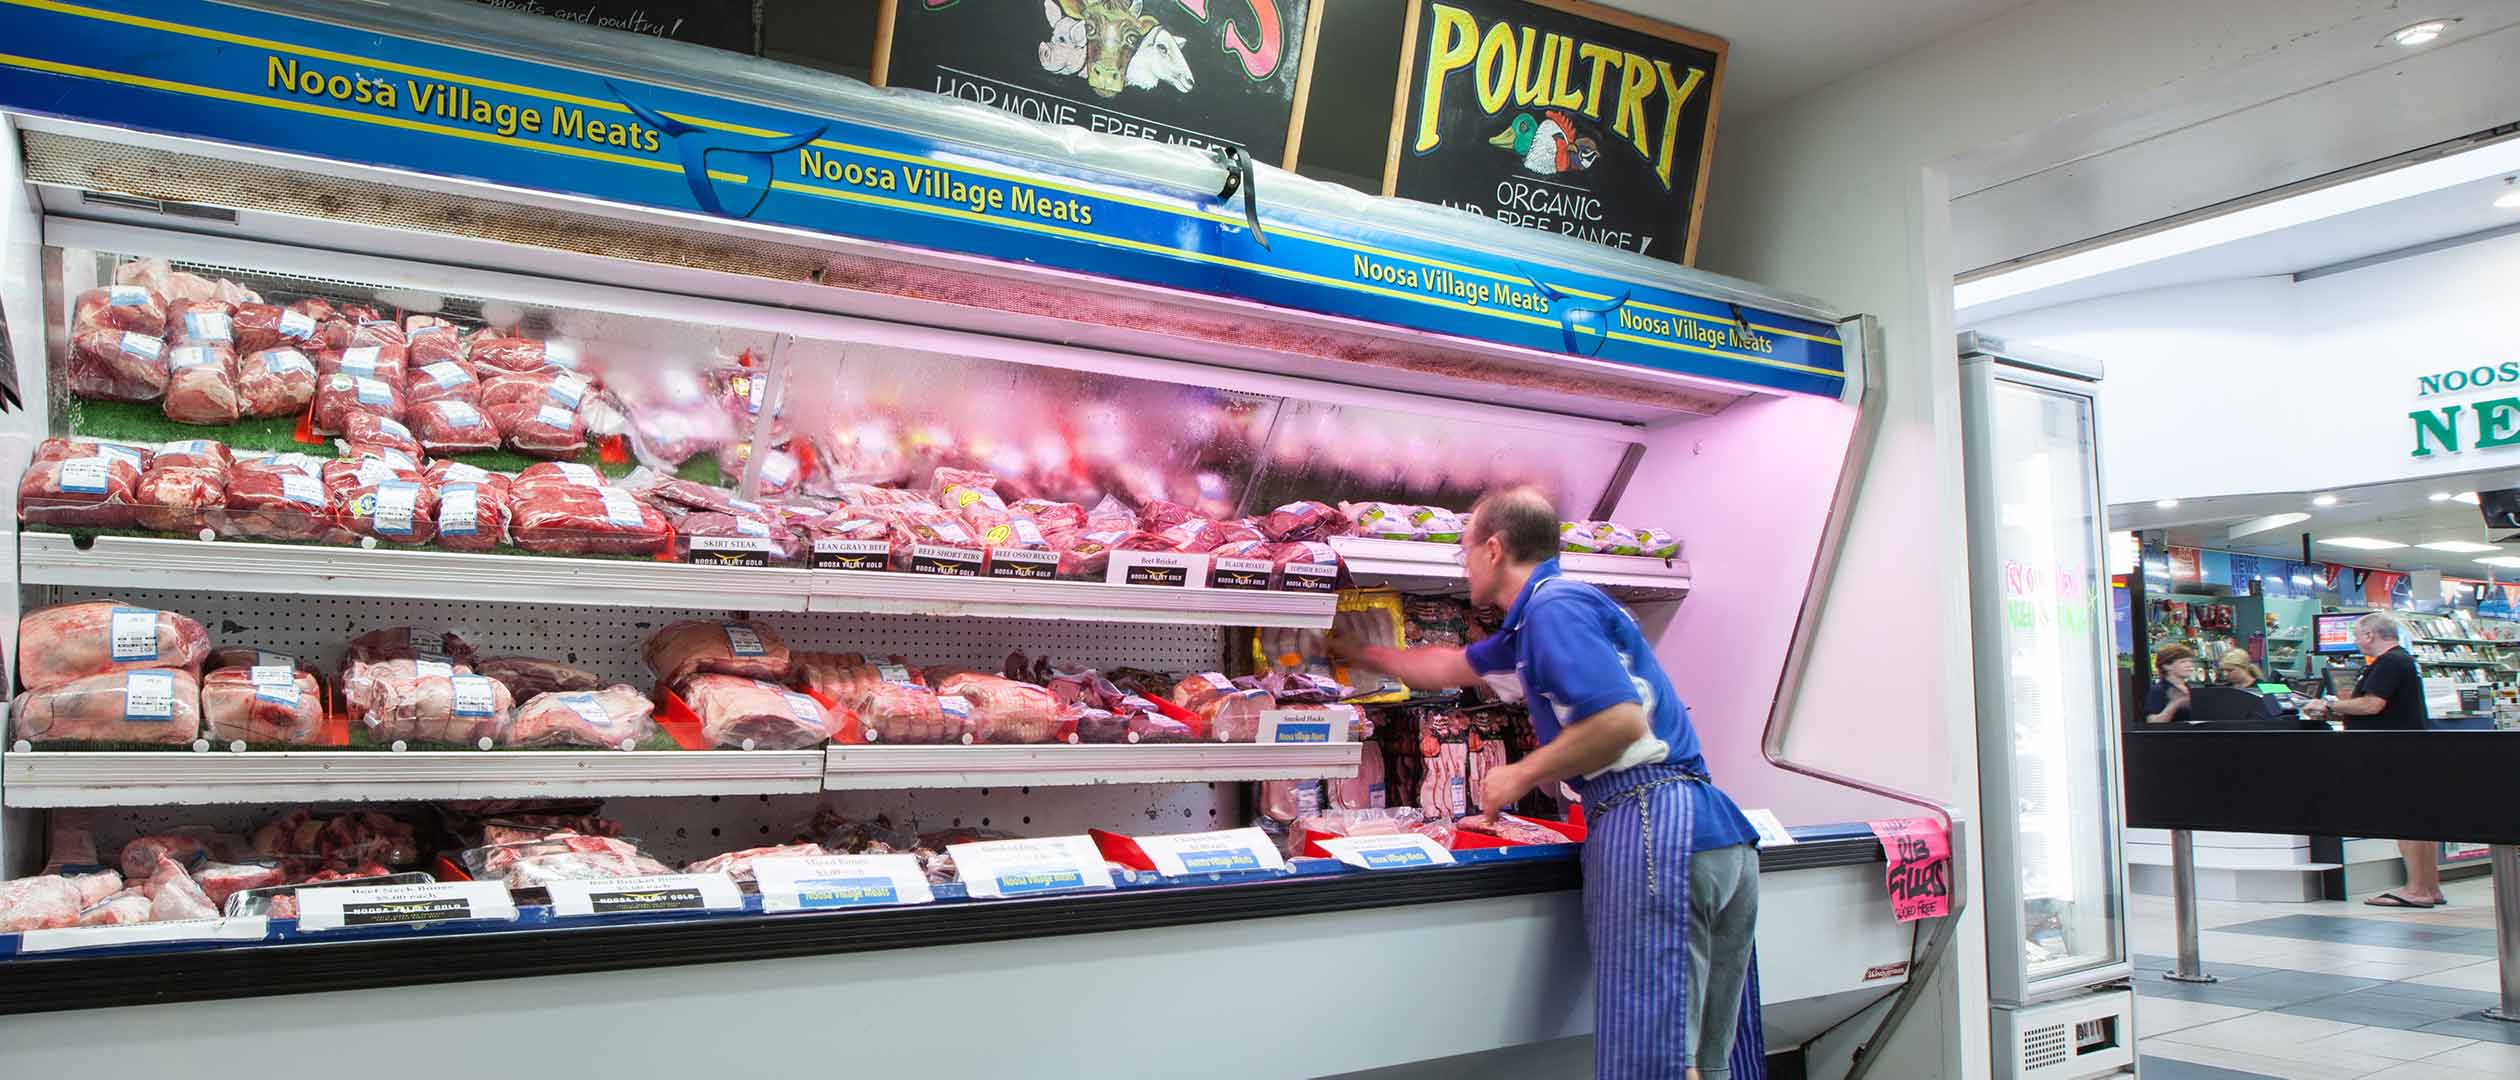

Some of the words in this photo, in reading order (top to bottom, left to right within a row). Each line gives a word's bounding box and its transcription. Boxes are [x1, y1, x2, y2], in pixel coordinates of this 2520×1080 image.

[554, 6, 596, 24] and
[599, 9, 664, 40] poultry
[267, 56, 397, 108] Noosa
[408, 81, 542, 136] Village
[551, 106, 661, 152] Meats
[1415, 4, 1704, 190] POULTRY
[800, 149, 895, 190] Noosa
[902, 166, 1003, 213] Village
[1011, 187, 1092, 225] Meats
[1497, 181, 1602, 221] ORGANIC
[1561, 221, 1632, 249] RANGE
[1354, 254, 1418, 288] Noosa
[1421, 267, 1488, 306] Village
[1494, 283, 1549, 313] Meats
[1619, 308, 1669, 336] Noosa
[1672, 318, 1725, 349] Village
[1729, 328, 1773, 353] Meats
[2417, 361, 2520, 396] NOOS
[2408, 397, 2520, 457] NE
[695, 558, 717, 566] NOOSA
[704, 540, 727, 548] SKIRT
[731, 540, 757, 549] STEAK
[817, 543, 838, 551] LEAN
[839, 543, 867, 551] GRAVY
[869, 544, 887, 552] BEEF
[918, 548, 935, 556] BEEF
[937, 550, 962, 558] SHORT
[963, 552, 981, 560] RIBS
[994, 550, 1011, 558] BEEF
[1033, 552, 1058, 560] BUCCO
